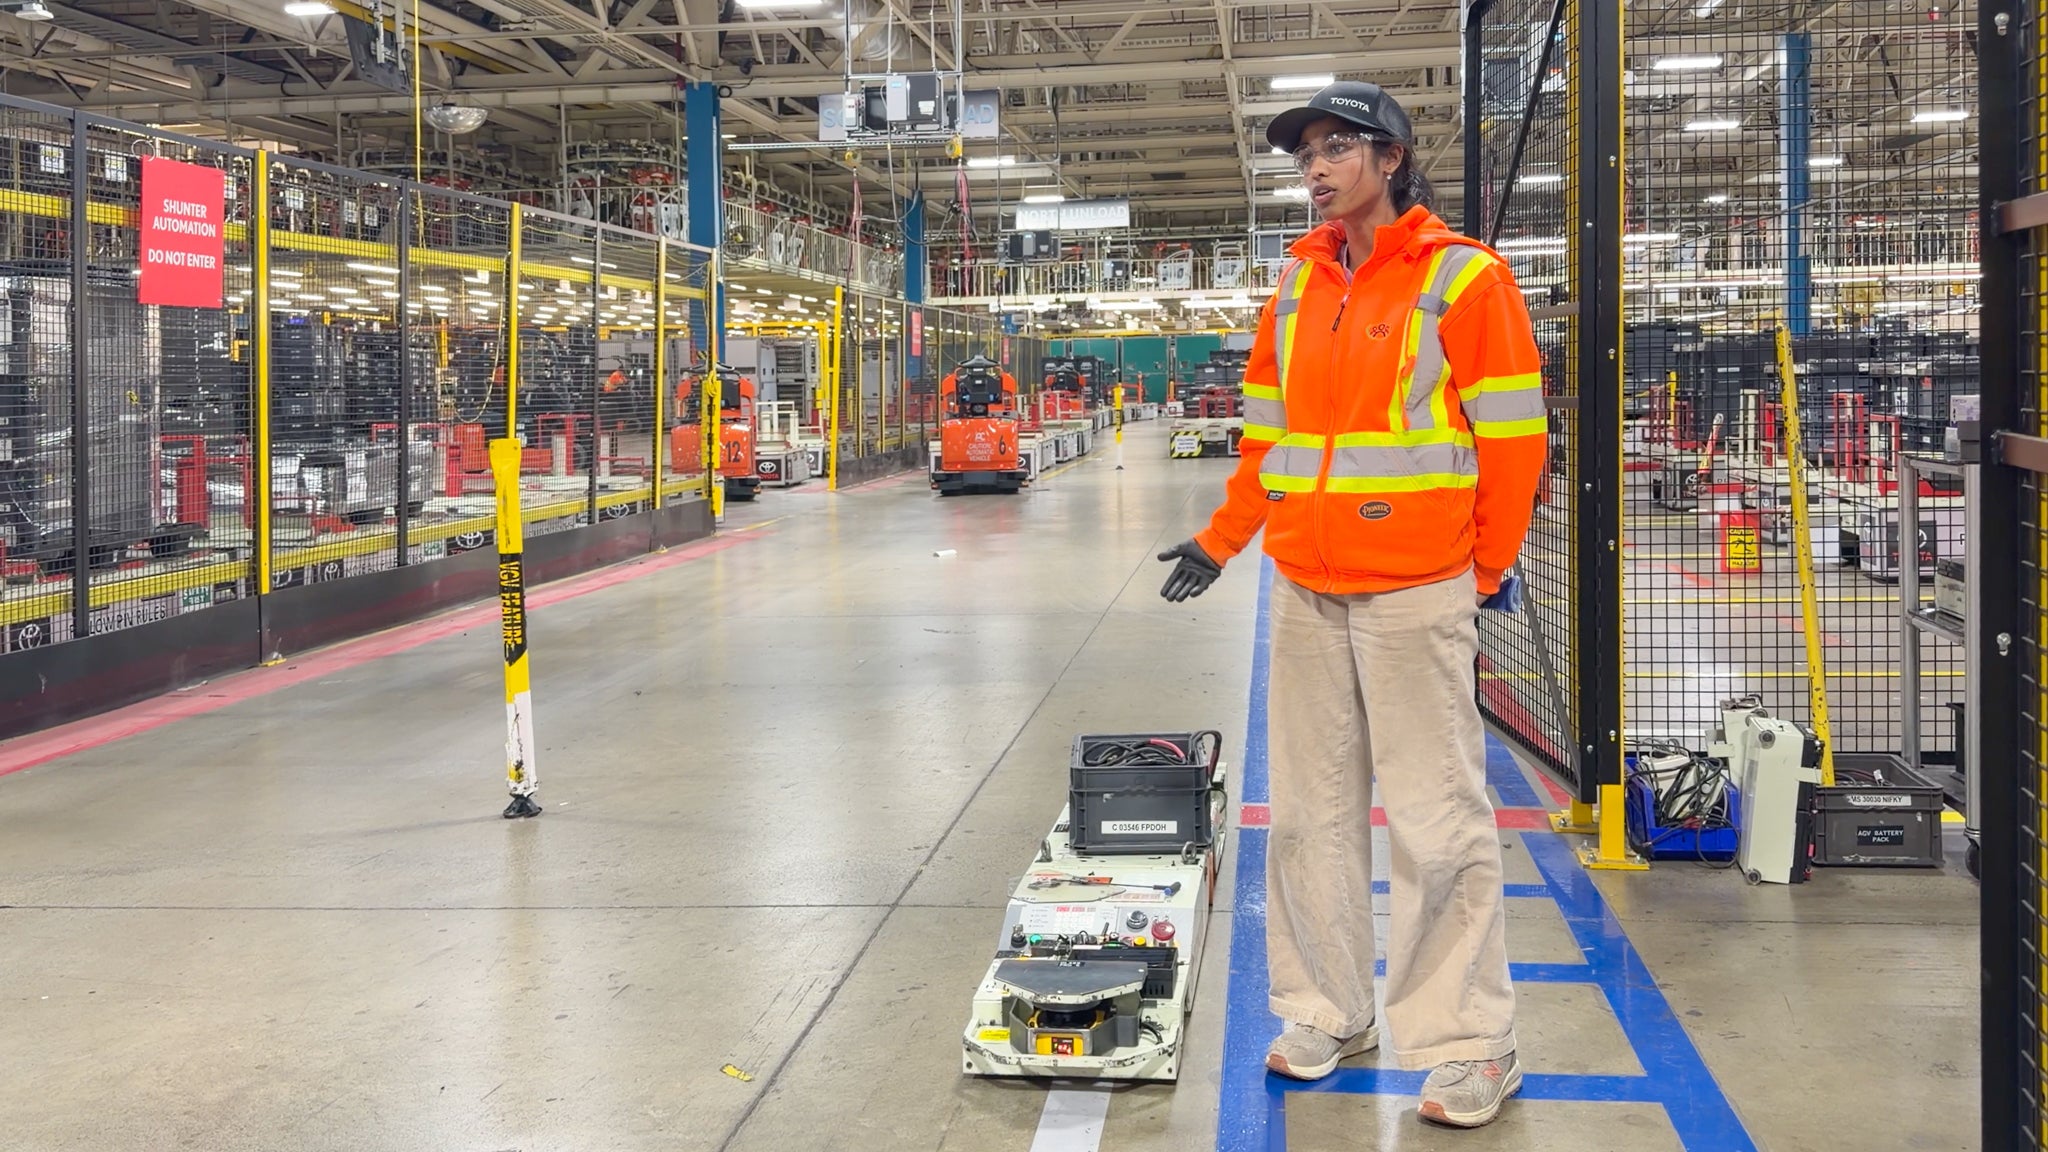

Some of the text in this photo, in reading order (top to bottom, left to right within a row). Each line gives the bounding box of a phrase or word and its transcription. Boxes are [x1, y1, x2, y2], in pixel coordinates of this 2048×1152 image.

[1330, 97, 1370, 113] TOYOTA
[163, 199, 207, 218] SHUNTER
[1019, 206, 1127, 220] NORTH UNLOAD
[152, 216, 216, 238] AUTOMATION
[148, 248, 216, 270] DO NOT ENTER
[725, 441, 741, 463] 12
[999, 435, 1006, 455] 6
[1874, 829, 1904, 837] BATTERY
